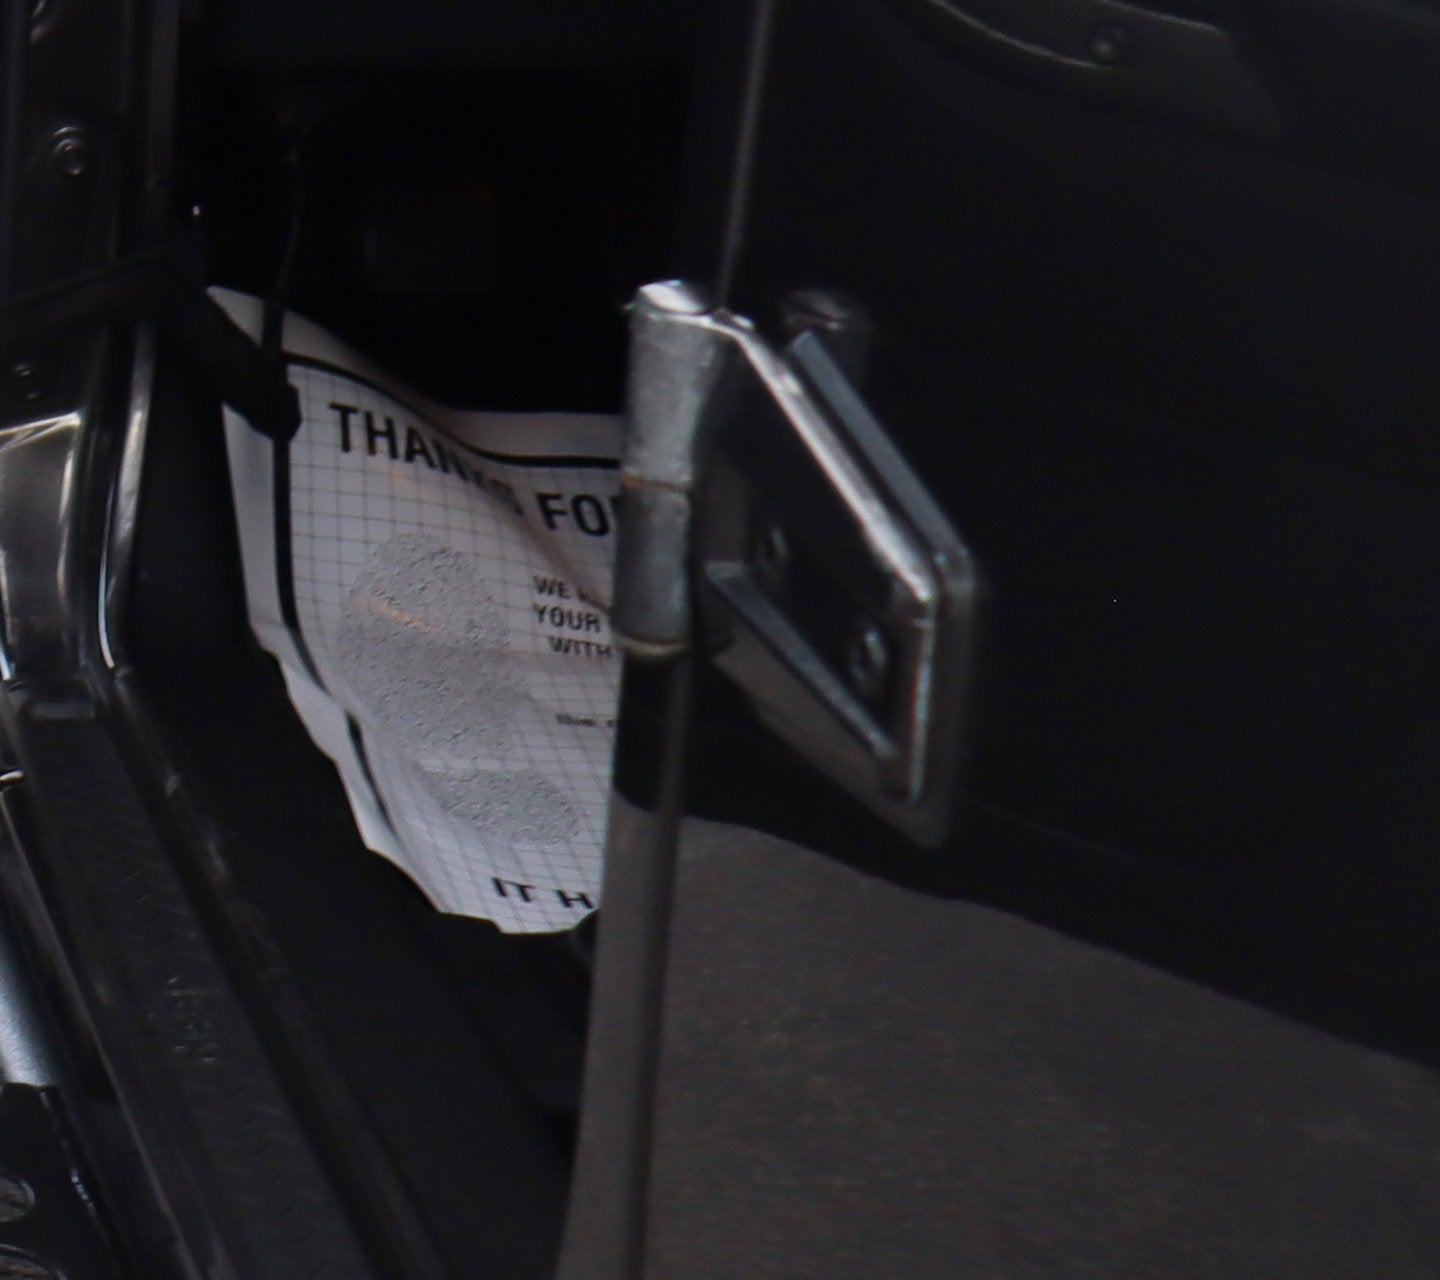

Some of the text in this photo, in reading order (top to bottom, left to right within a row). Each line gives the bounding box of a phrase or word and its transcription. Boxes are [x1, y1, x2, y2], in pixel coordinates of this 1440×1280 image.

[536, 492, 622, 538] FO
[532, 573, 571, 599] WE
[532, 602, 601, 633] YOUR
[547, 635, 613, 658] WITH
[491, 876, 536, 903] IT
